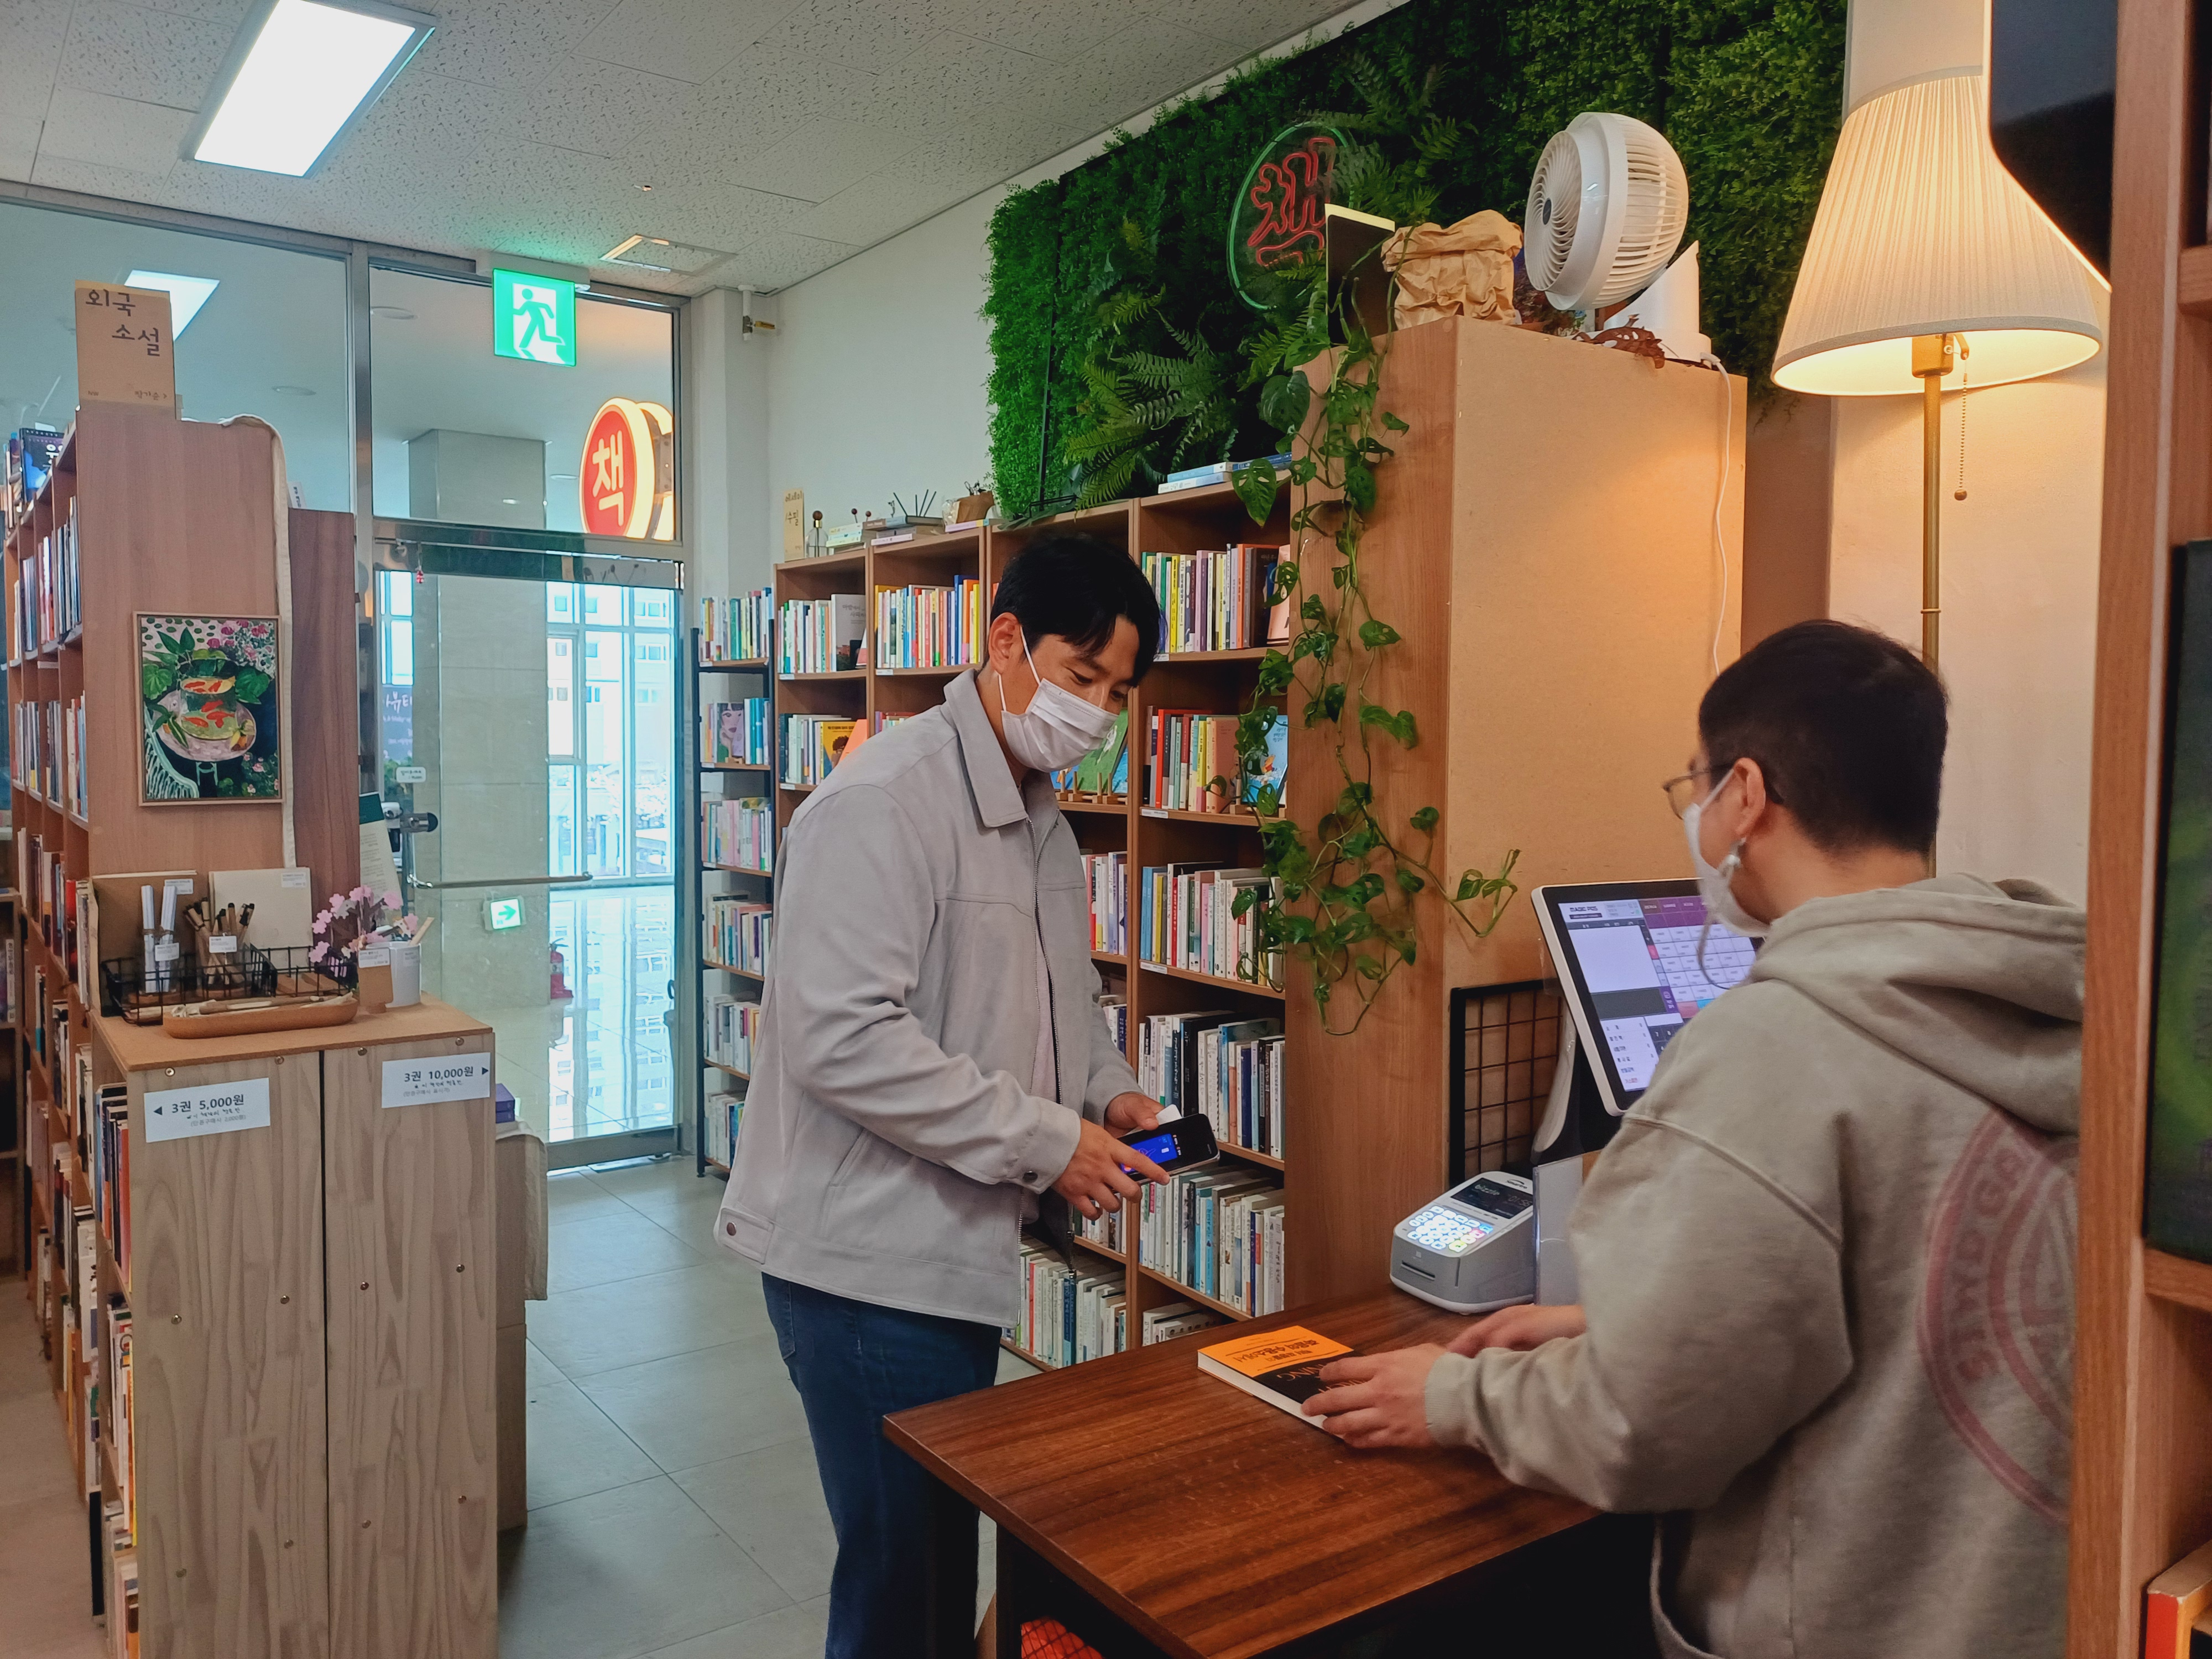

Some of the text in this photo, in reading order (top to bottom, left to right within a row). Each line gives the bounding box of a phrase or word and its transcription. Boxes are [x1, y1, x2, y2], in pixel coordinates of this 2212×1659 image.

[86, 289, 135, 316] 외국
[112, 324, 160, 357] 소설
[592, 429, 625, 526] 책
[404, 1066, 473, 1082] 3권 10,000원
[172, 1094, 244, 1113] 3권 5,000원
